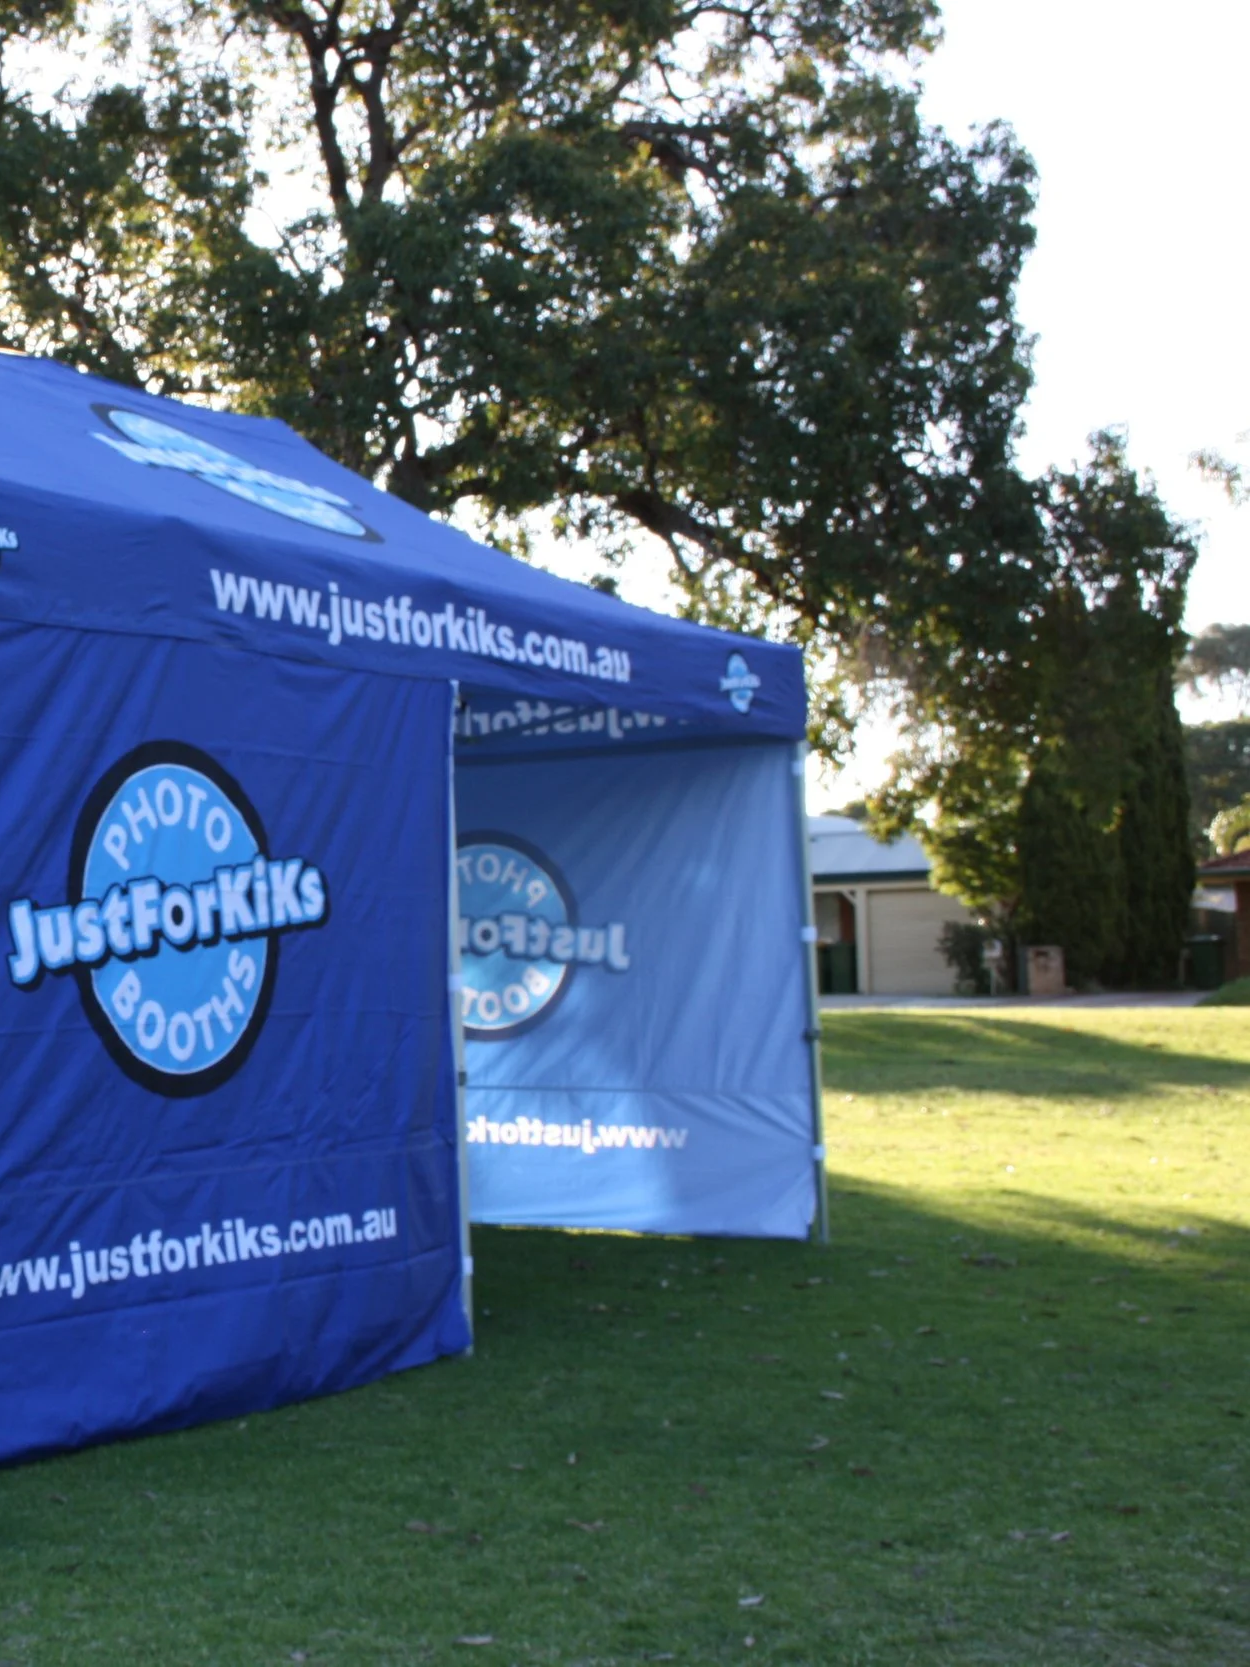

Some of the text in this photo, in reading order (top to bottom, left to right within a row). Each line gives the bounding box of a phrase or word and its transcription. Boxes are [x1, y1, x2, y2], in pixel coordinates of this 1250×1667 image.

[210, 569, 631, 683] www.justforkiks.com.au
[103, 778, 232, 871] PHOTO
[8, 854, 325, 984] JustForKiKs
[111, 949, 256, 1061] BOOTHS
